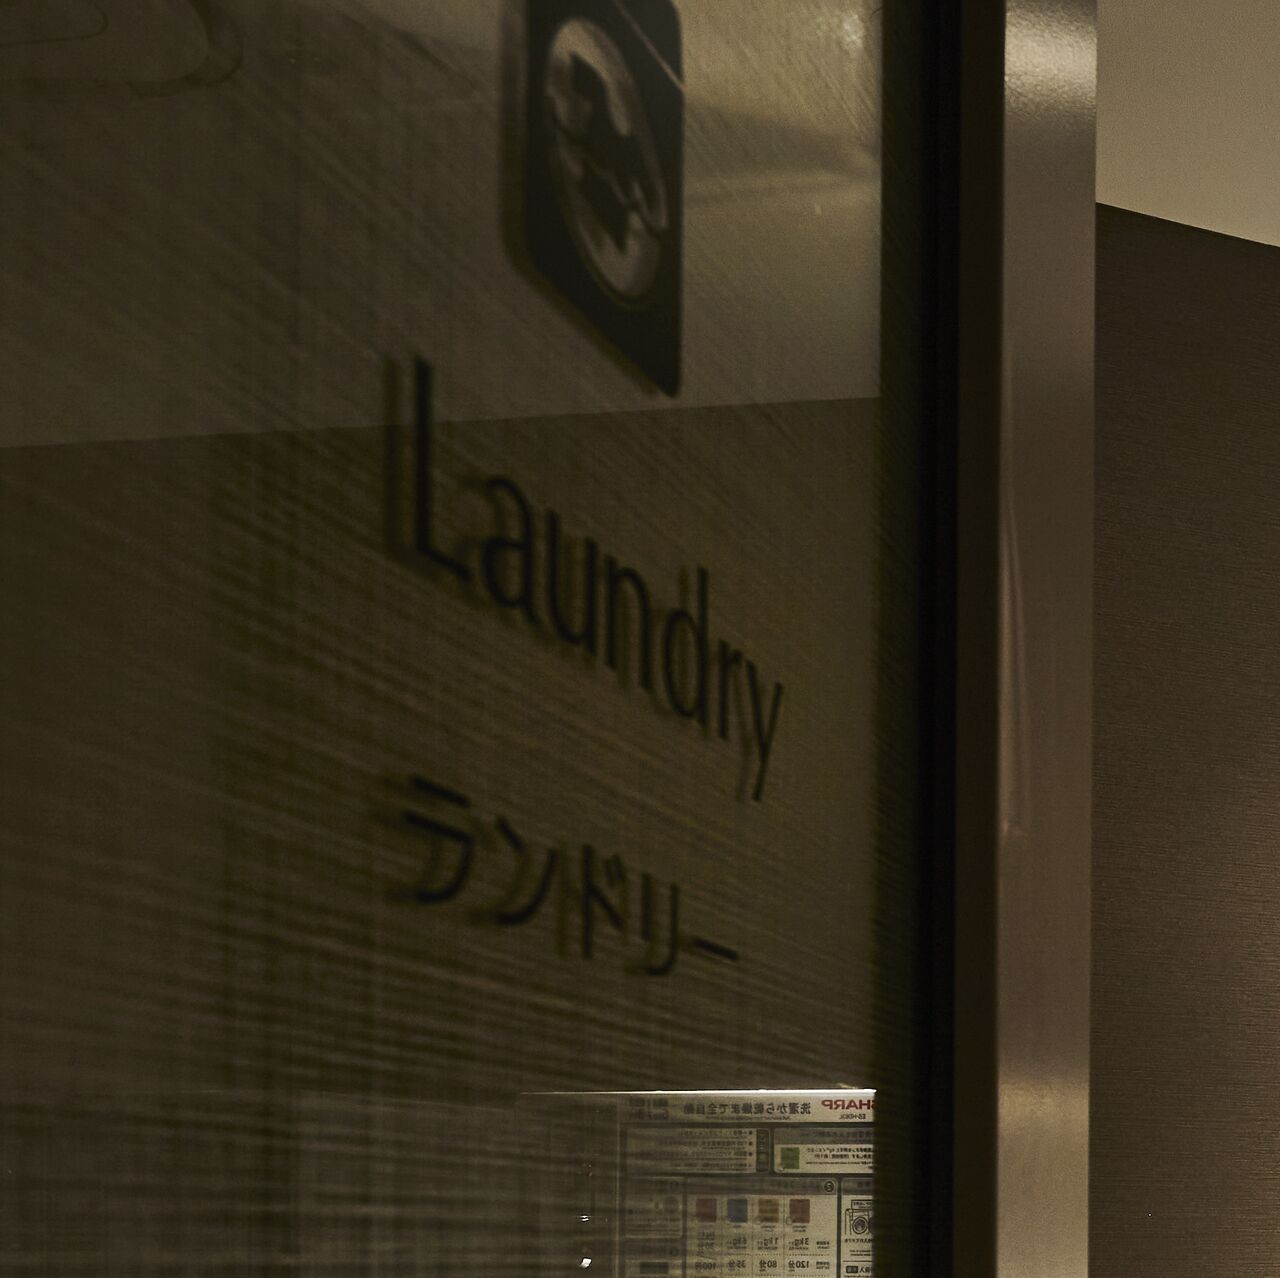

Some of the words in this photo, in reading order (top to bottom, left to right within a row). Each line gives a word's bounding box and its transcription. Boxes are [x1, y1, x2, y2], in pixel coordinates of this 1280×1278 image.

[412, 356, 785, 802] Laundry
[400, 776, 739, 976] ランドリー
